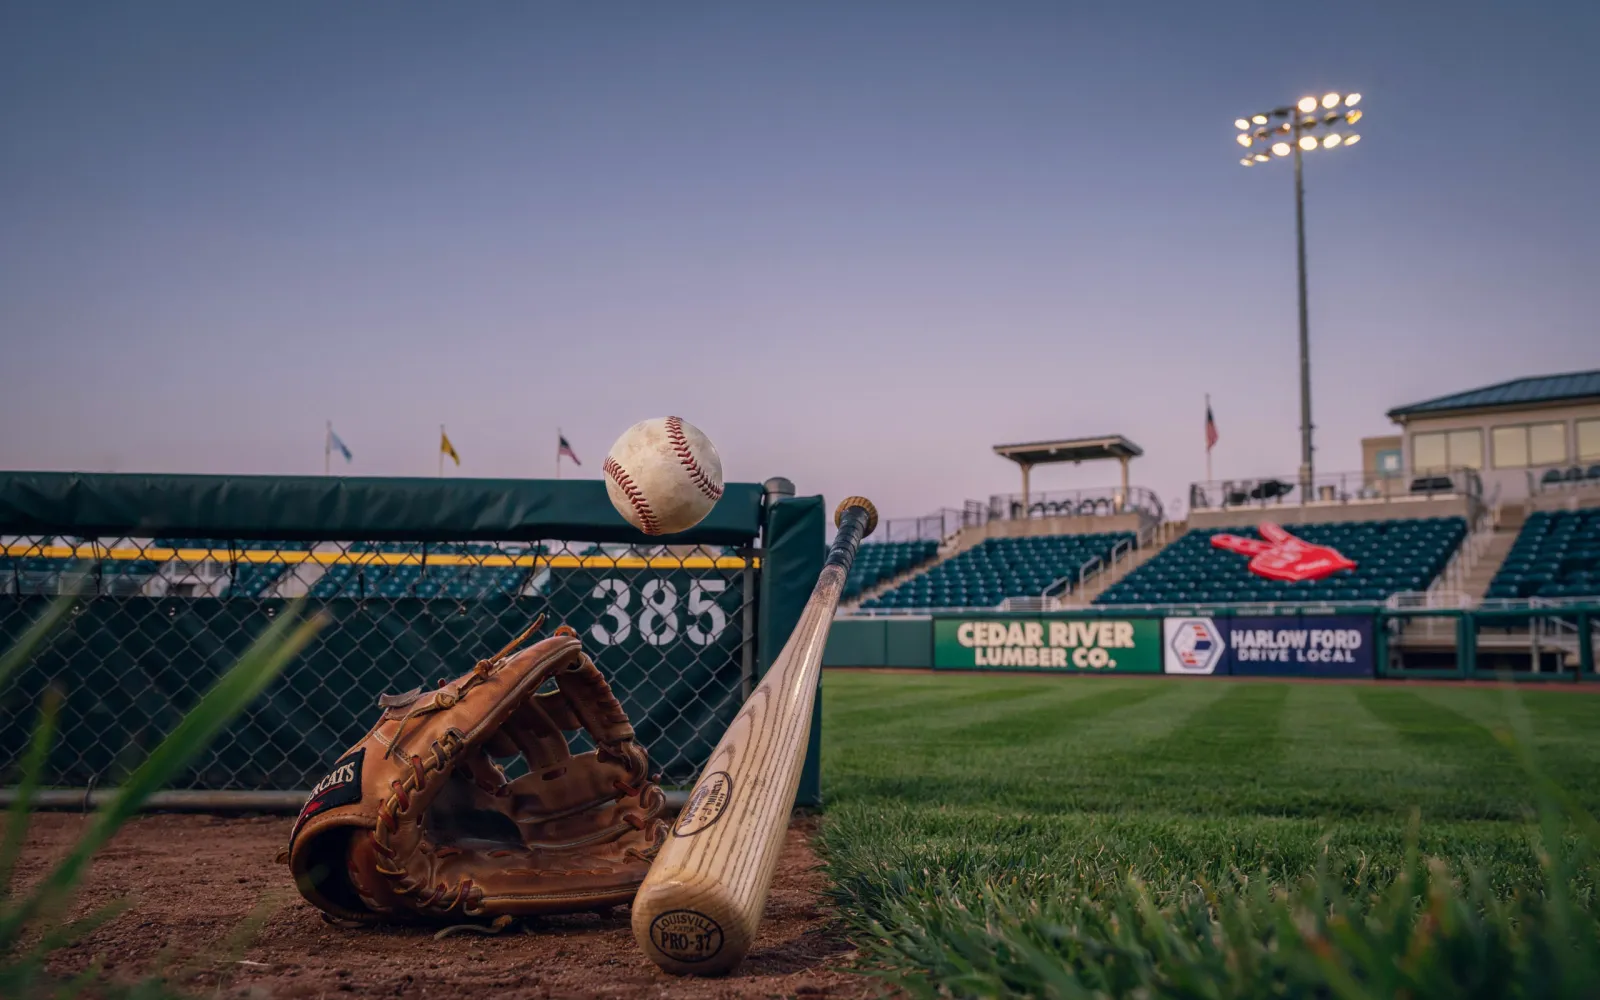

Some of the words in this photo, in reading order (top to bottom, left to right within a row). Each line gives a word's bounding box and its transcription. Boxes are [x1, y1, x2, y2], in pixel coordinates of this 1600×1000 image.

[591, 579, 726, 646] 385
[957, 622, 1043, 647] CEDAR
[1049, 622, 1135, 648] RIVER
[1230, 630, 1307, 649] HARLOW
[1310, 630, 1362, 649] FORD
[975, 647, 1067, 667] LUMBER
[1072, 648, 1116, 668] CO.
[1238, 649, 1289, 662] DRIVE
[1297, 650, 1356, 663] LOCAL
[661, 932, 712, 951] PRO-37
